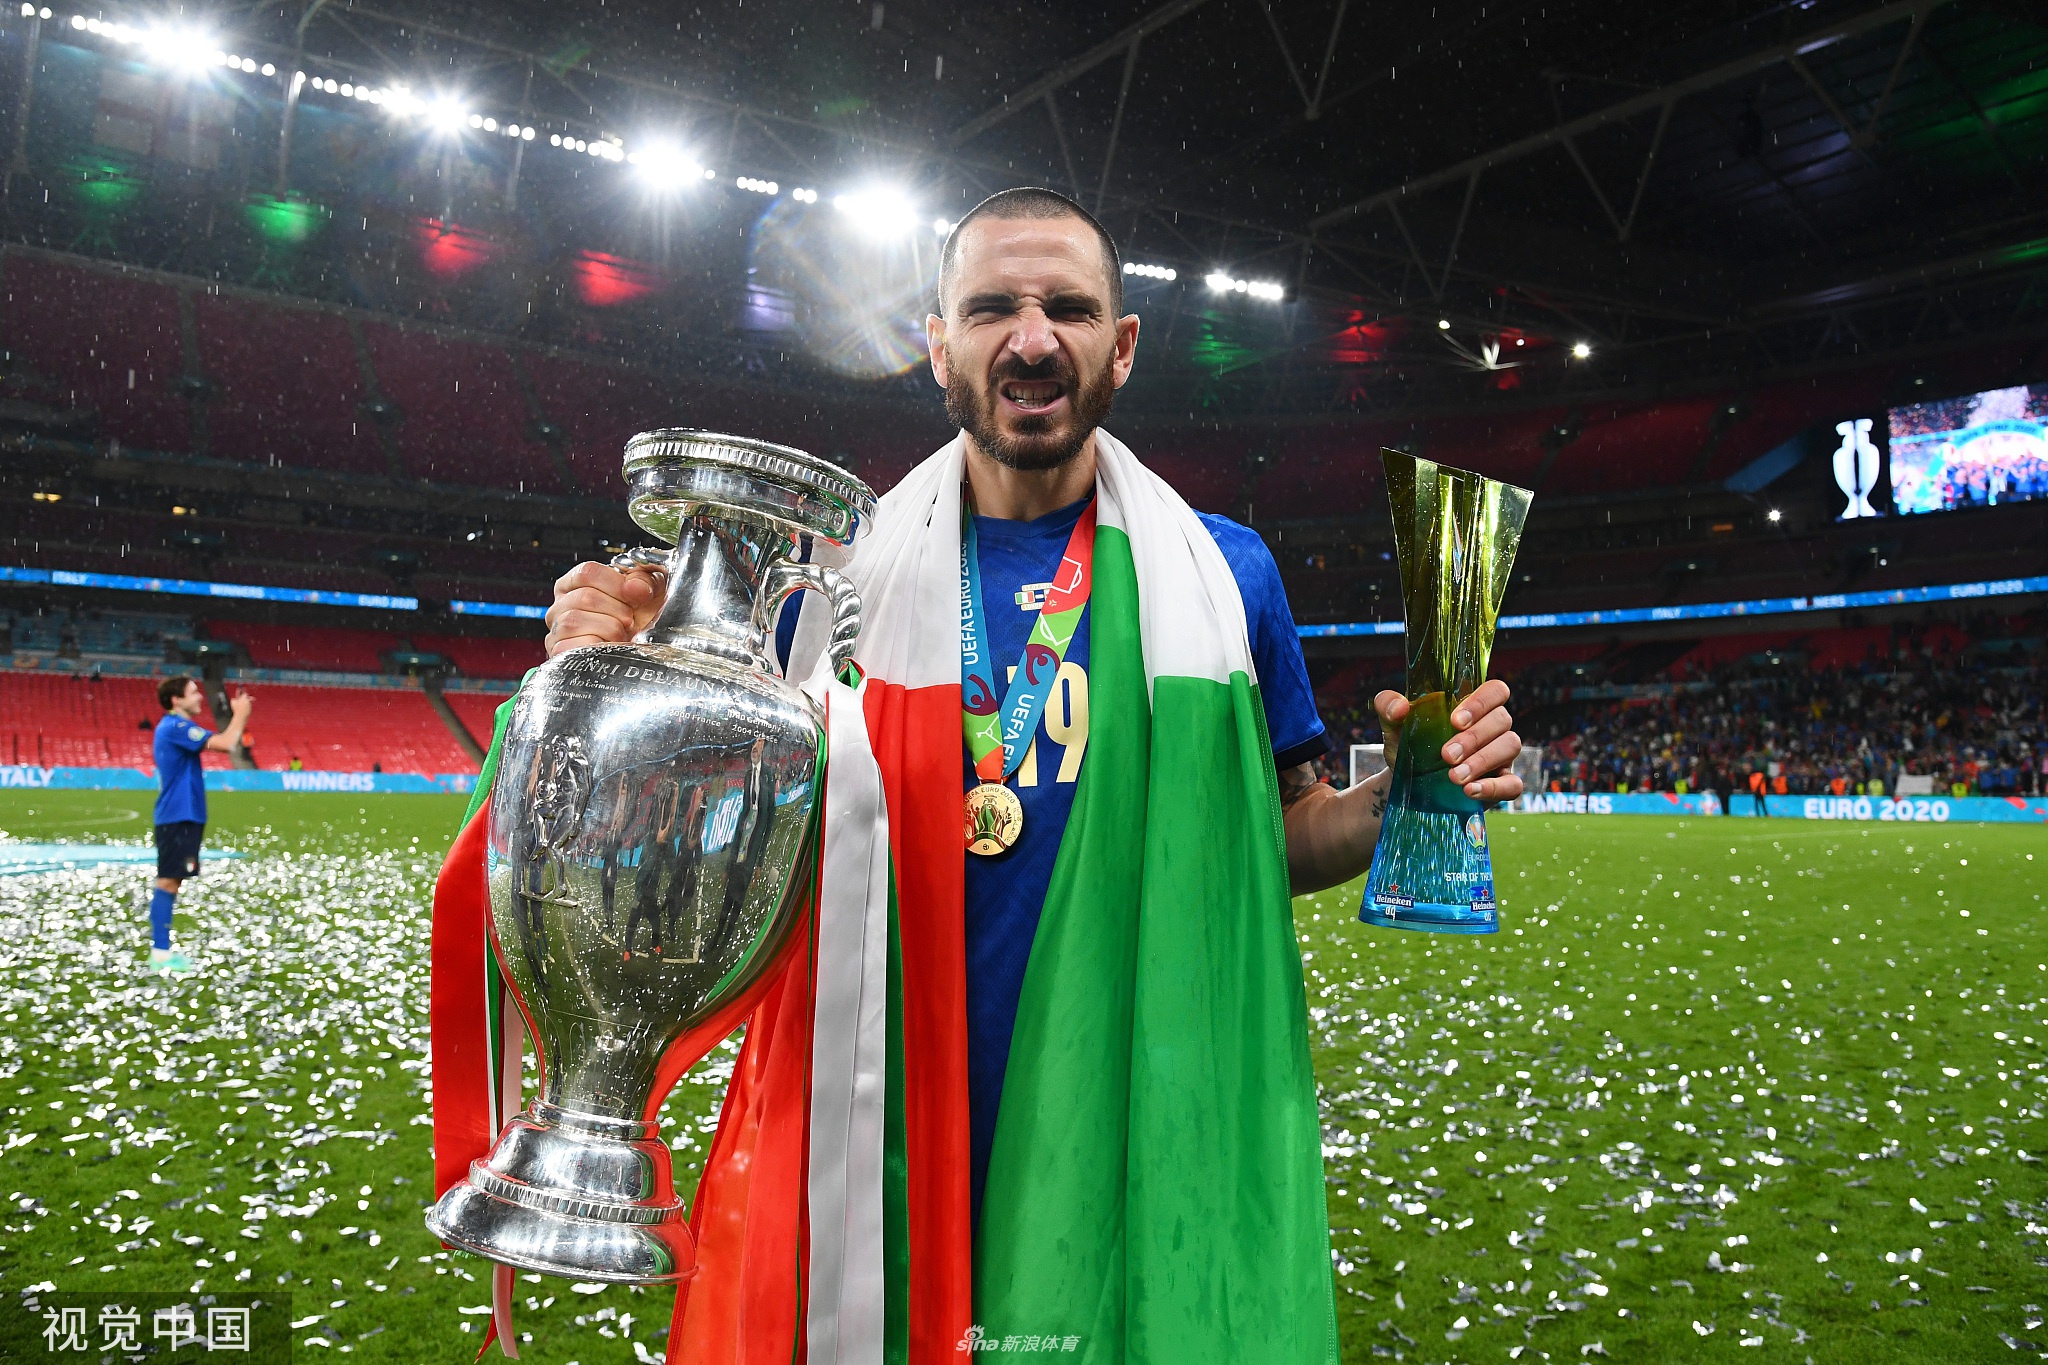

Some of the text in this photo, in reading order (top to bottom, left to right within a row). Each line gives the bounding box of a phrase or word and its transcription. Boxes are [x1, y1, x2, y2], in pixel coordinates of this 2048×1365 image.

[1951, 584, 1986, 598] EURO
[962, 620, 979, 666] UEFA
[563, 659, 620, 676] HENRI
[692, 714, 721, 727] France
[1003, 693, 1035, 740] UEFA
[731, 723, 752, 736] 2004
[282, 772, 375, 792] WINNERS
[1804, 797, 1950, 822] EURO 2020
[1445, 872, 1468, 882] STAR
[1469, 872, 1479, 882] OF
[1376, 895, 1412, 907] Heineken
